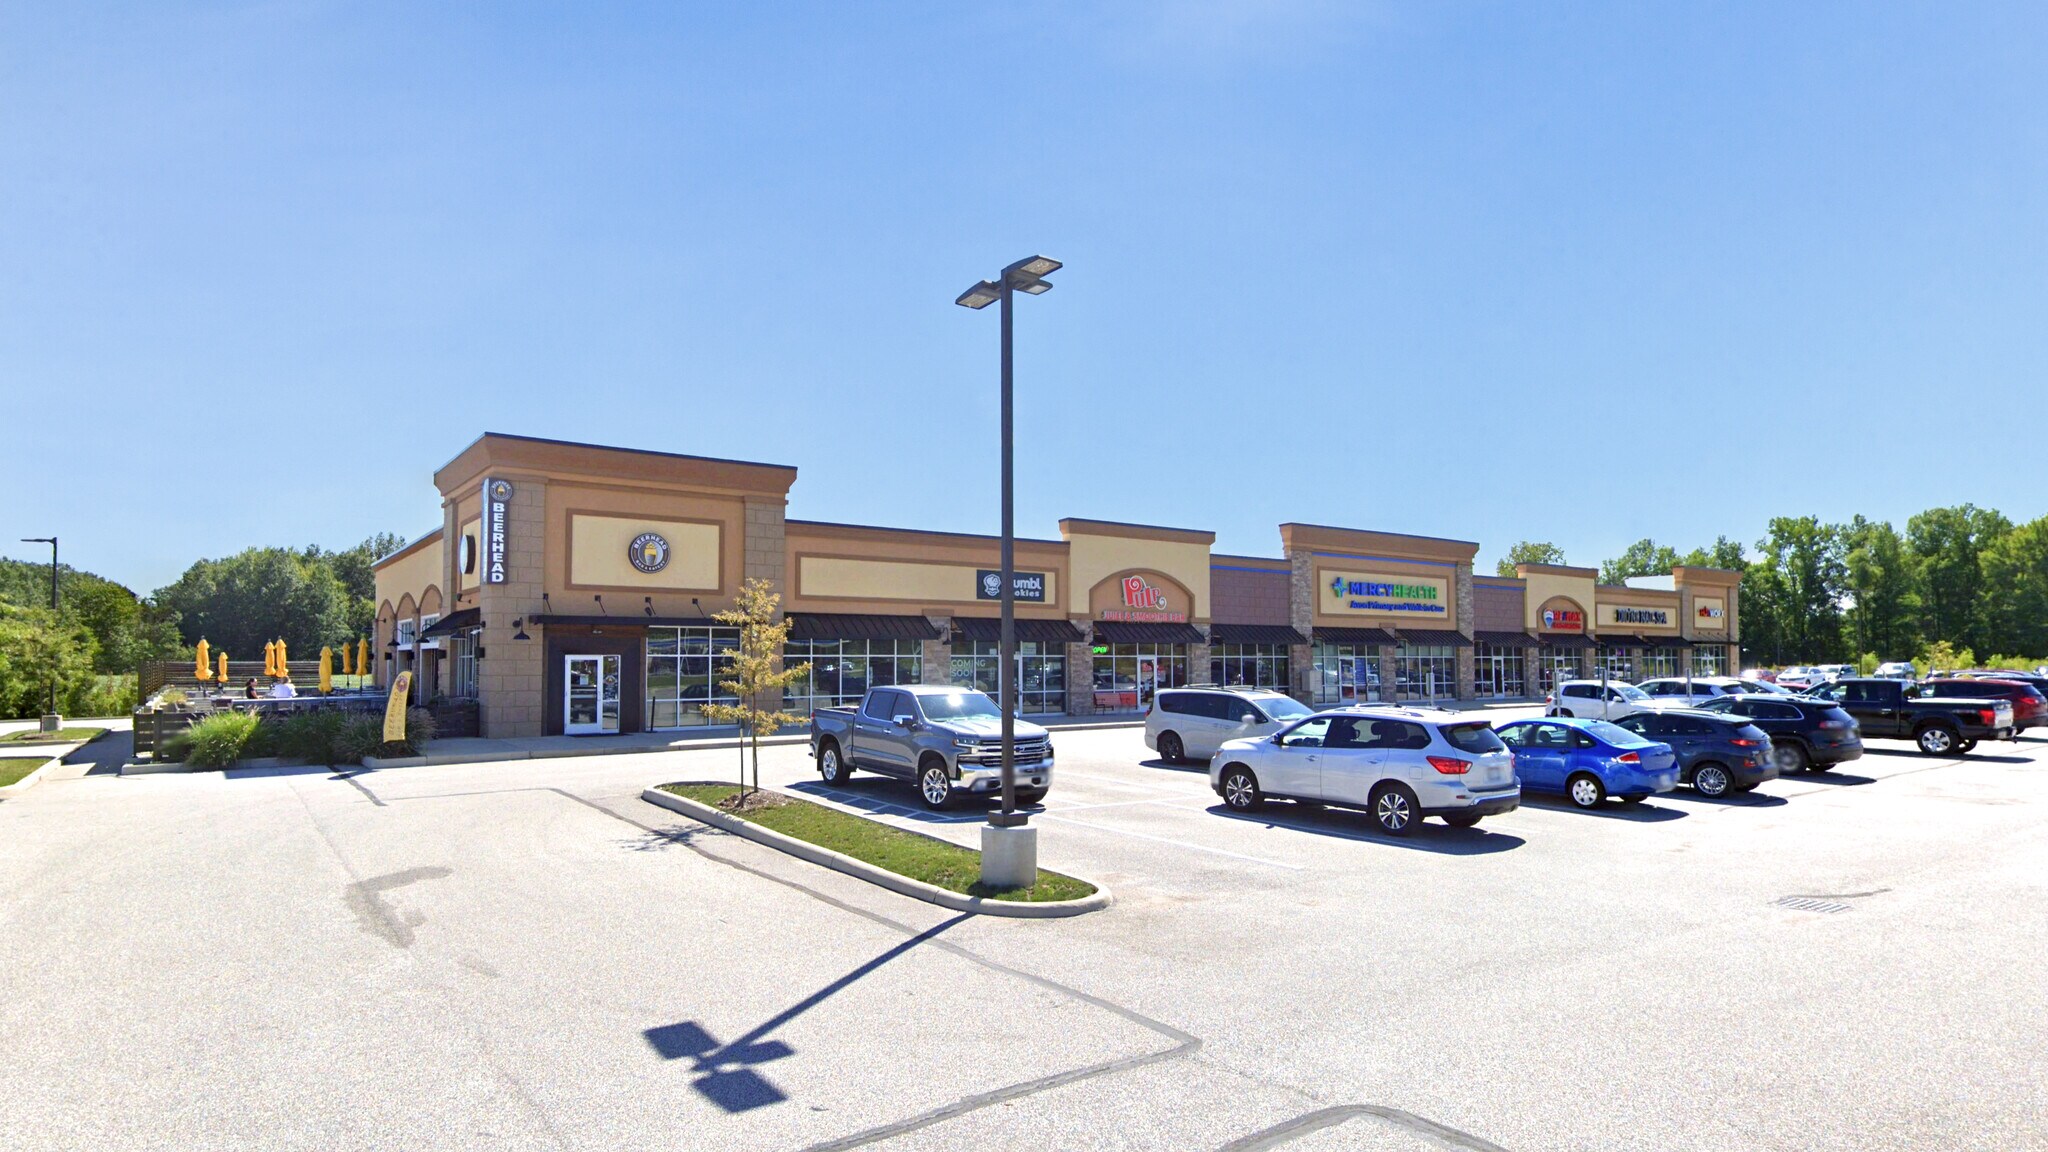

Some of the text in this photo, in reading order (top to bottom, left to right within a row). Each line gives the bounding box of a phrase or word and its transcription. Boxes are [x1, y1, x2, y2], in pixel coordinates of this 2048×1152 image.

[491, 502, 505, 582] BEERHEAD
[633, 535, 667, 550] BEERHEAD
[1013, 577, 1042, 590] umbl
[1014, 589, 1040, 597] okies
[951, 659, 986, 667] COMING
